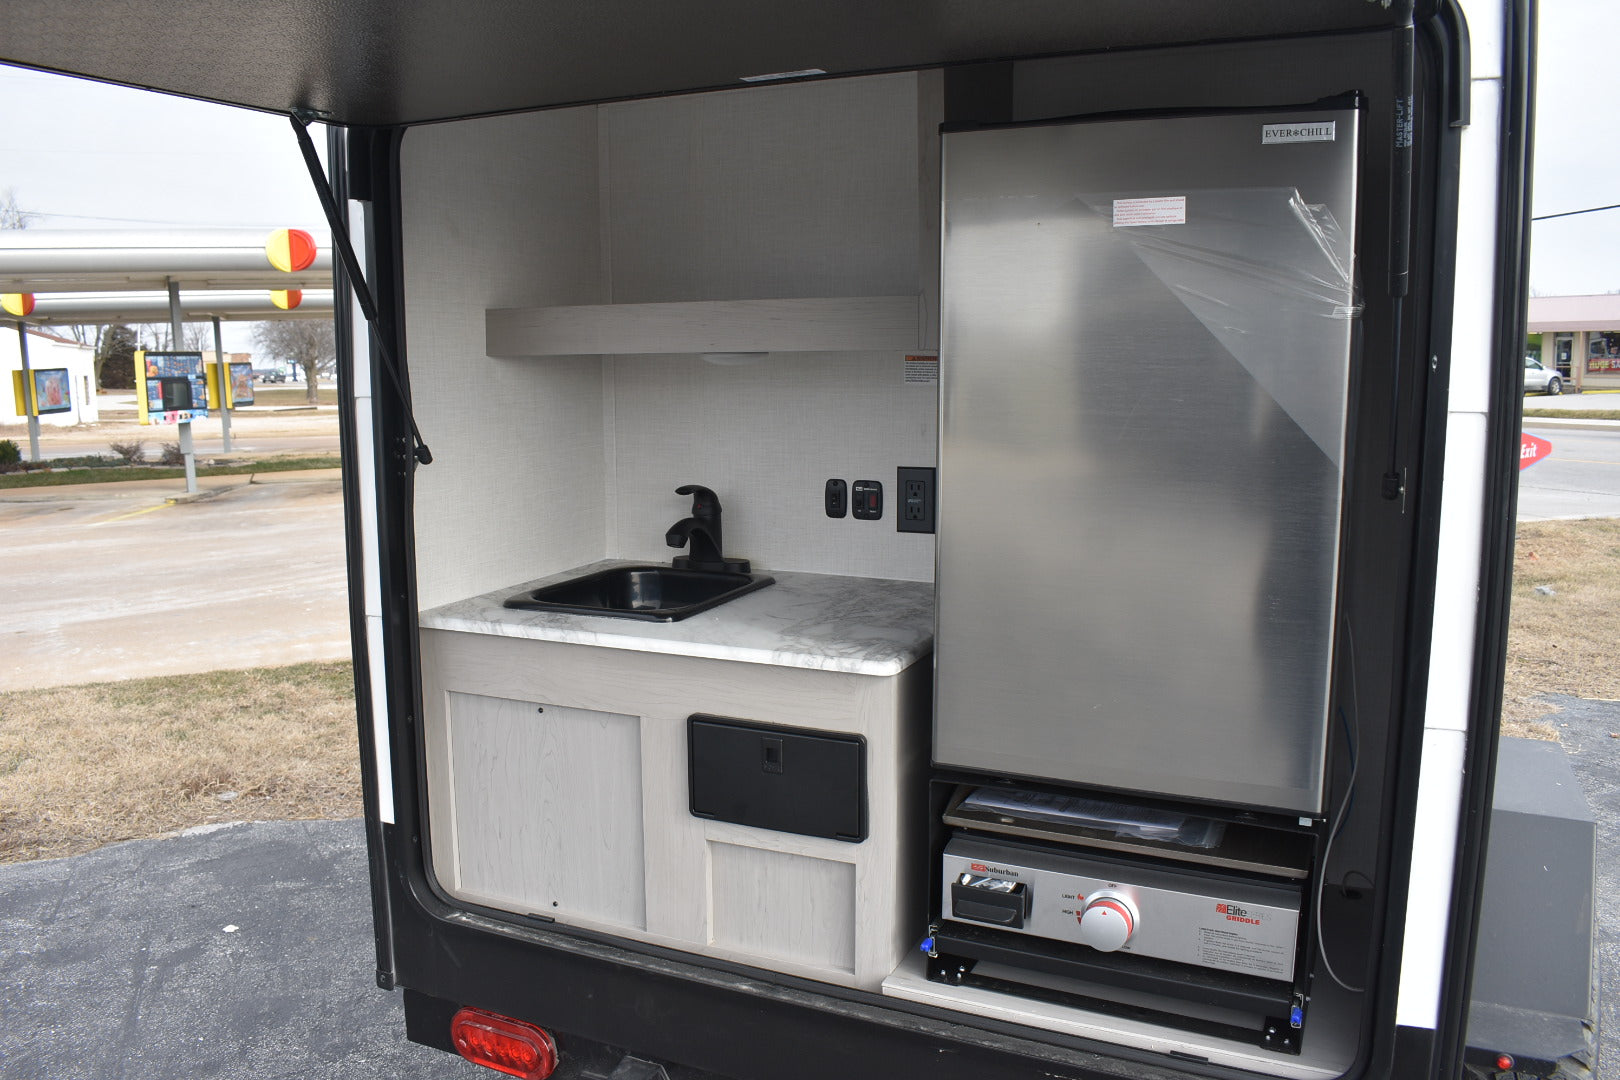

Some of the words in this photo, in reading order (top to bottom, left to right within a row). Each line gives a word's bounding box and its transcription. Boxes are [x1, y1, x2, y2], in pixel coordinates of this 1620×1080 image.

[1396, 98, 1404, 147] MASTER-LIFT
[1265, 129, 1292, 138] EVER
[1300, 127, 1332, 137] CHILL
[1589, 360, 1610, 369] HUGE
[1520, 443, 1536, 459] Exit
[985, 866, 1019, 877] Suburban
[1226, 904, 1248, 917] Elite
[1226, 915, 1260, 925] GRIDDLE
